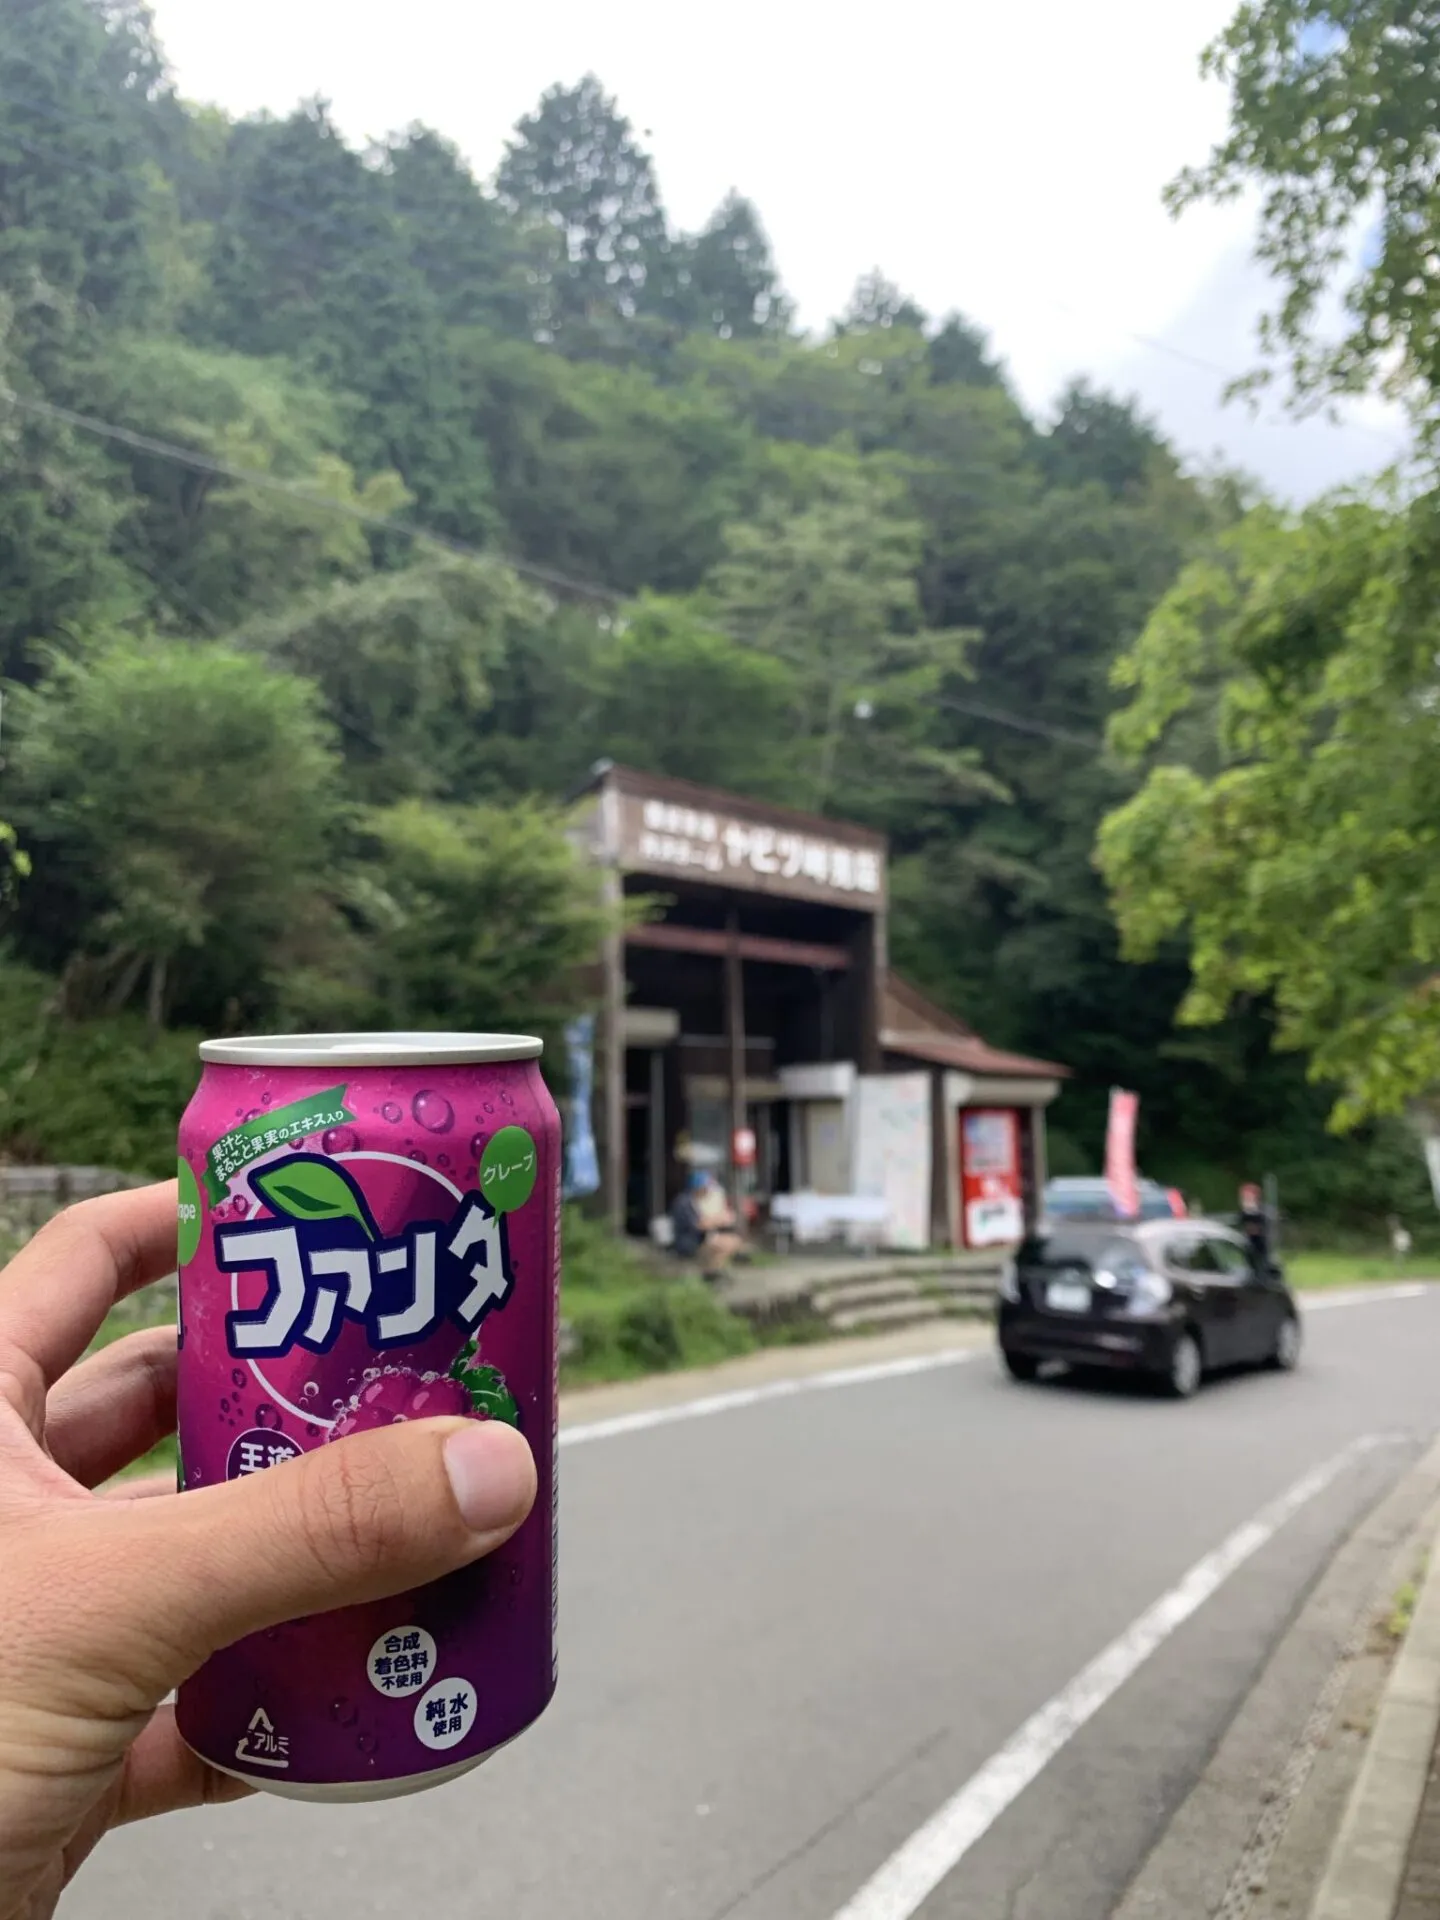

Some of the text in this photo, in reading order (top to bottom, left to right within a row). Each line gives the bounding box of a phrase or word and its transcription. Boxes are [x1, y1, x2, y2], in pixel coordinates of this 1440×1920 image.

[722, 820, 881, 893] ヤビツ
[214, 1111, 344, 1182] まるごと果実のエキス入り
[220, 1203, 508, 1348] ファンタ
[384, 1632, 420, 1653] 合成
[374, 1650, 428, 1675] 着色料
[381, 1671, 422, 1690] 不使用
[425, 1692, 468, 1721] 純水
[432, 1715, 462, 1737] 使用
[254, 1732, 289, 1754] アルミ
